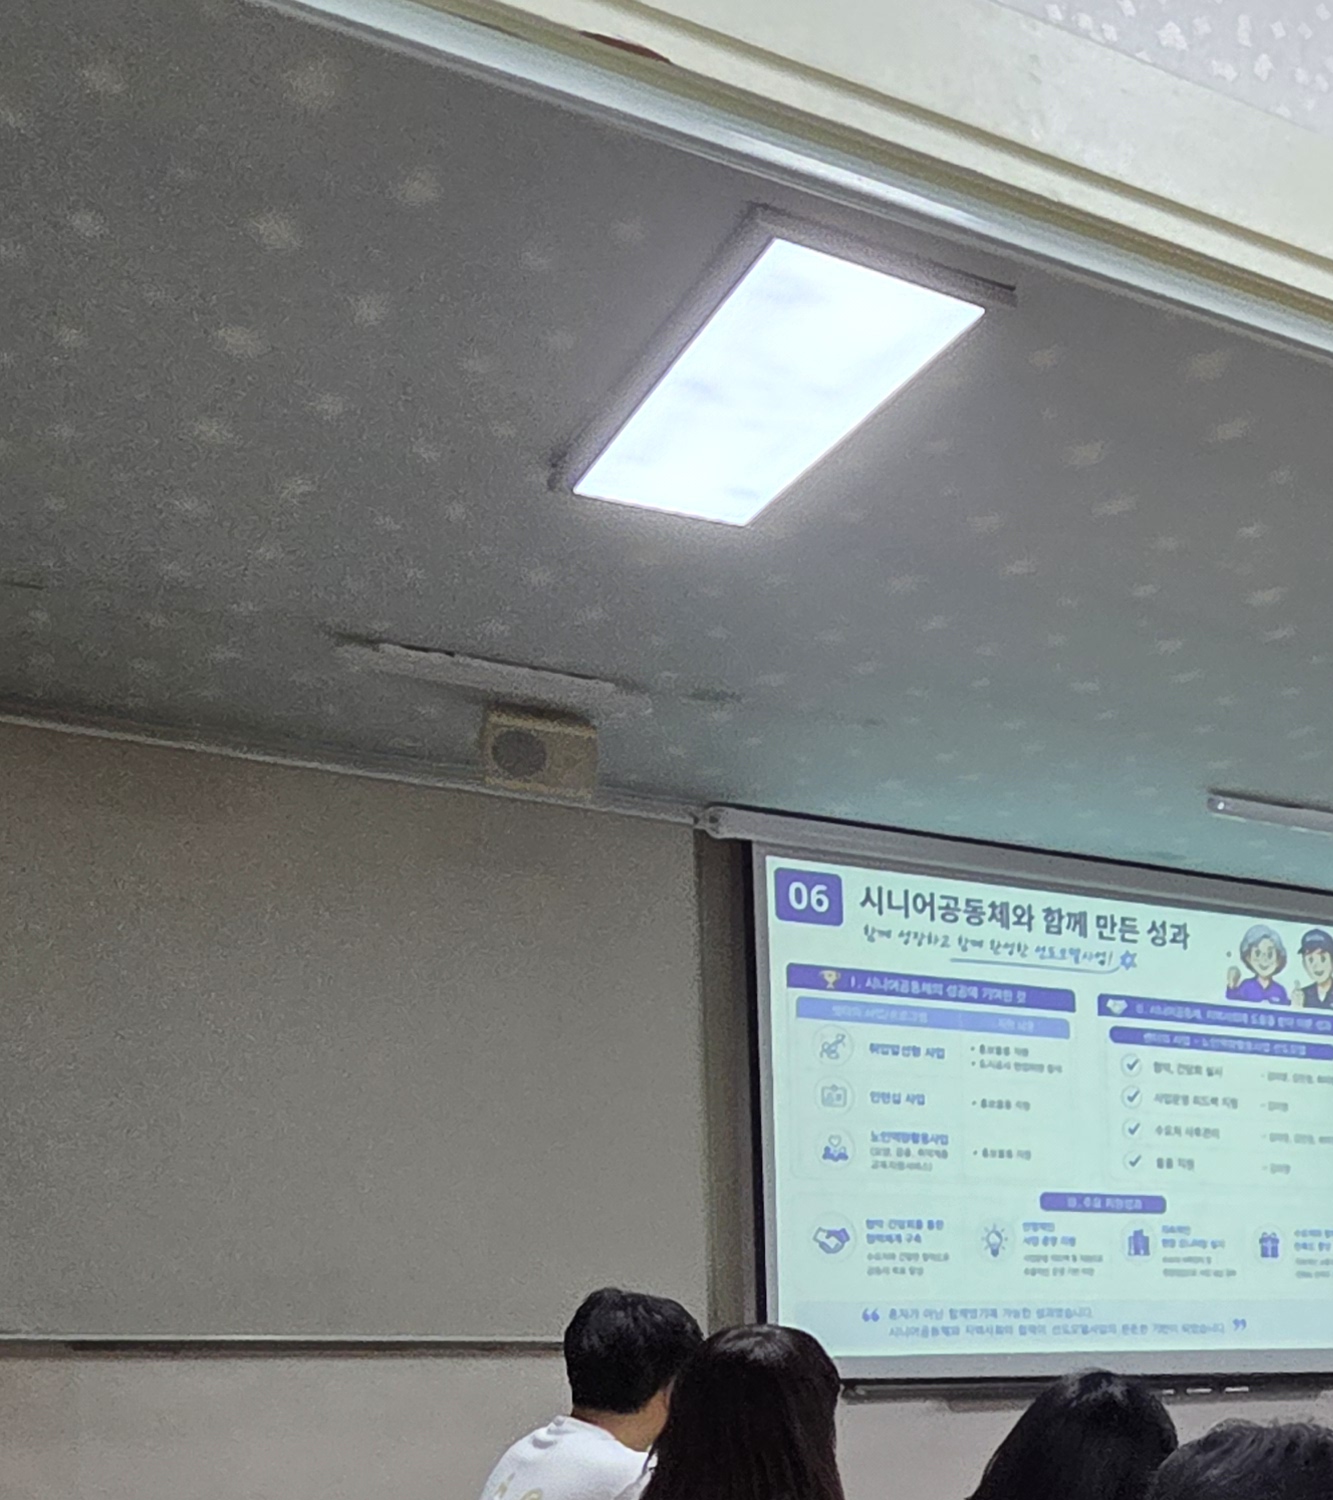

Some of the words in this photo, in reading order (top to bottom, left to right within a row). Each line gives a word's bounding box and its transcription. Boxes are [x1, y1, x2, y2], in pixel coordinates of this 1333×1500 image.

[788, 881, 830, 912] 06
[860, 885, 1034, 932] 시니어공동체와
[1042, 906, 1088, 938] 함께
[1096, 914, 1140, 944] 만든
[1147, 920, 1190, 950] 성과
